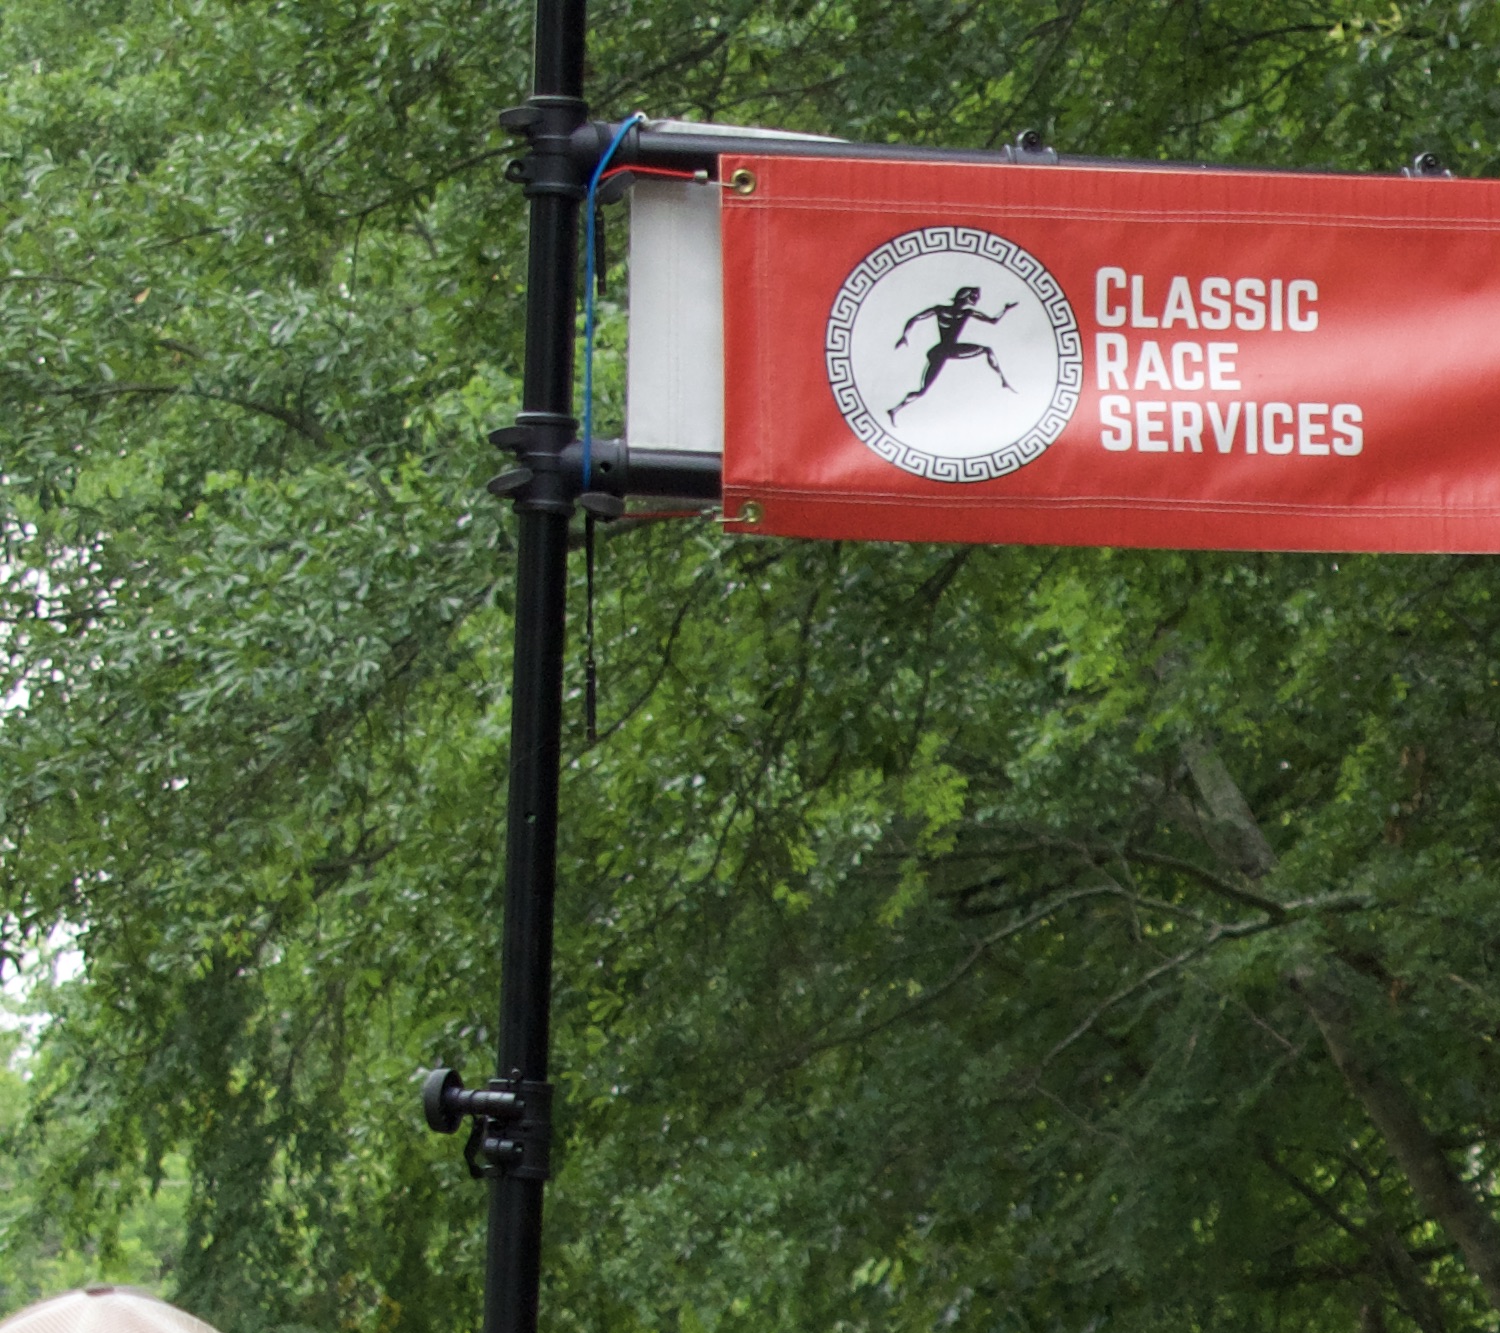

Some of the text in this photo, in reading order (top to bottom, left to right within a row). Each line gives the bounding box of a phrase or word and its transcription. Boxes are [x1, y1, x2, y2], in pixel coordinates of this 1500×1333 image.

[1095, 267, 1318, 332] CLASSIC
[1095, 333, 1241, 391] RACE
[1100, 395, 1363, 456] SERVICES
